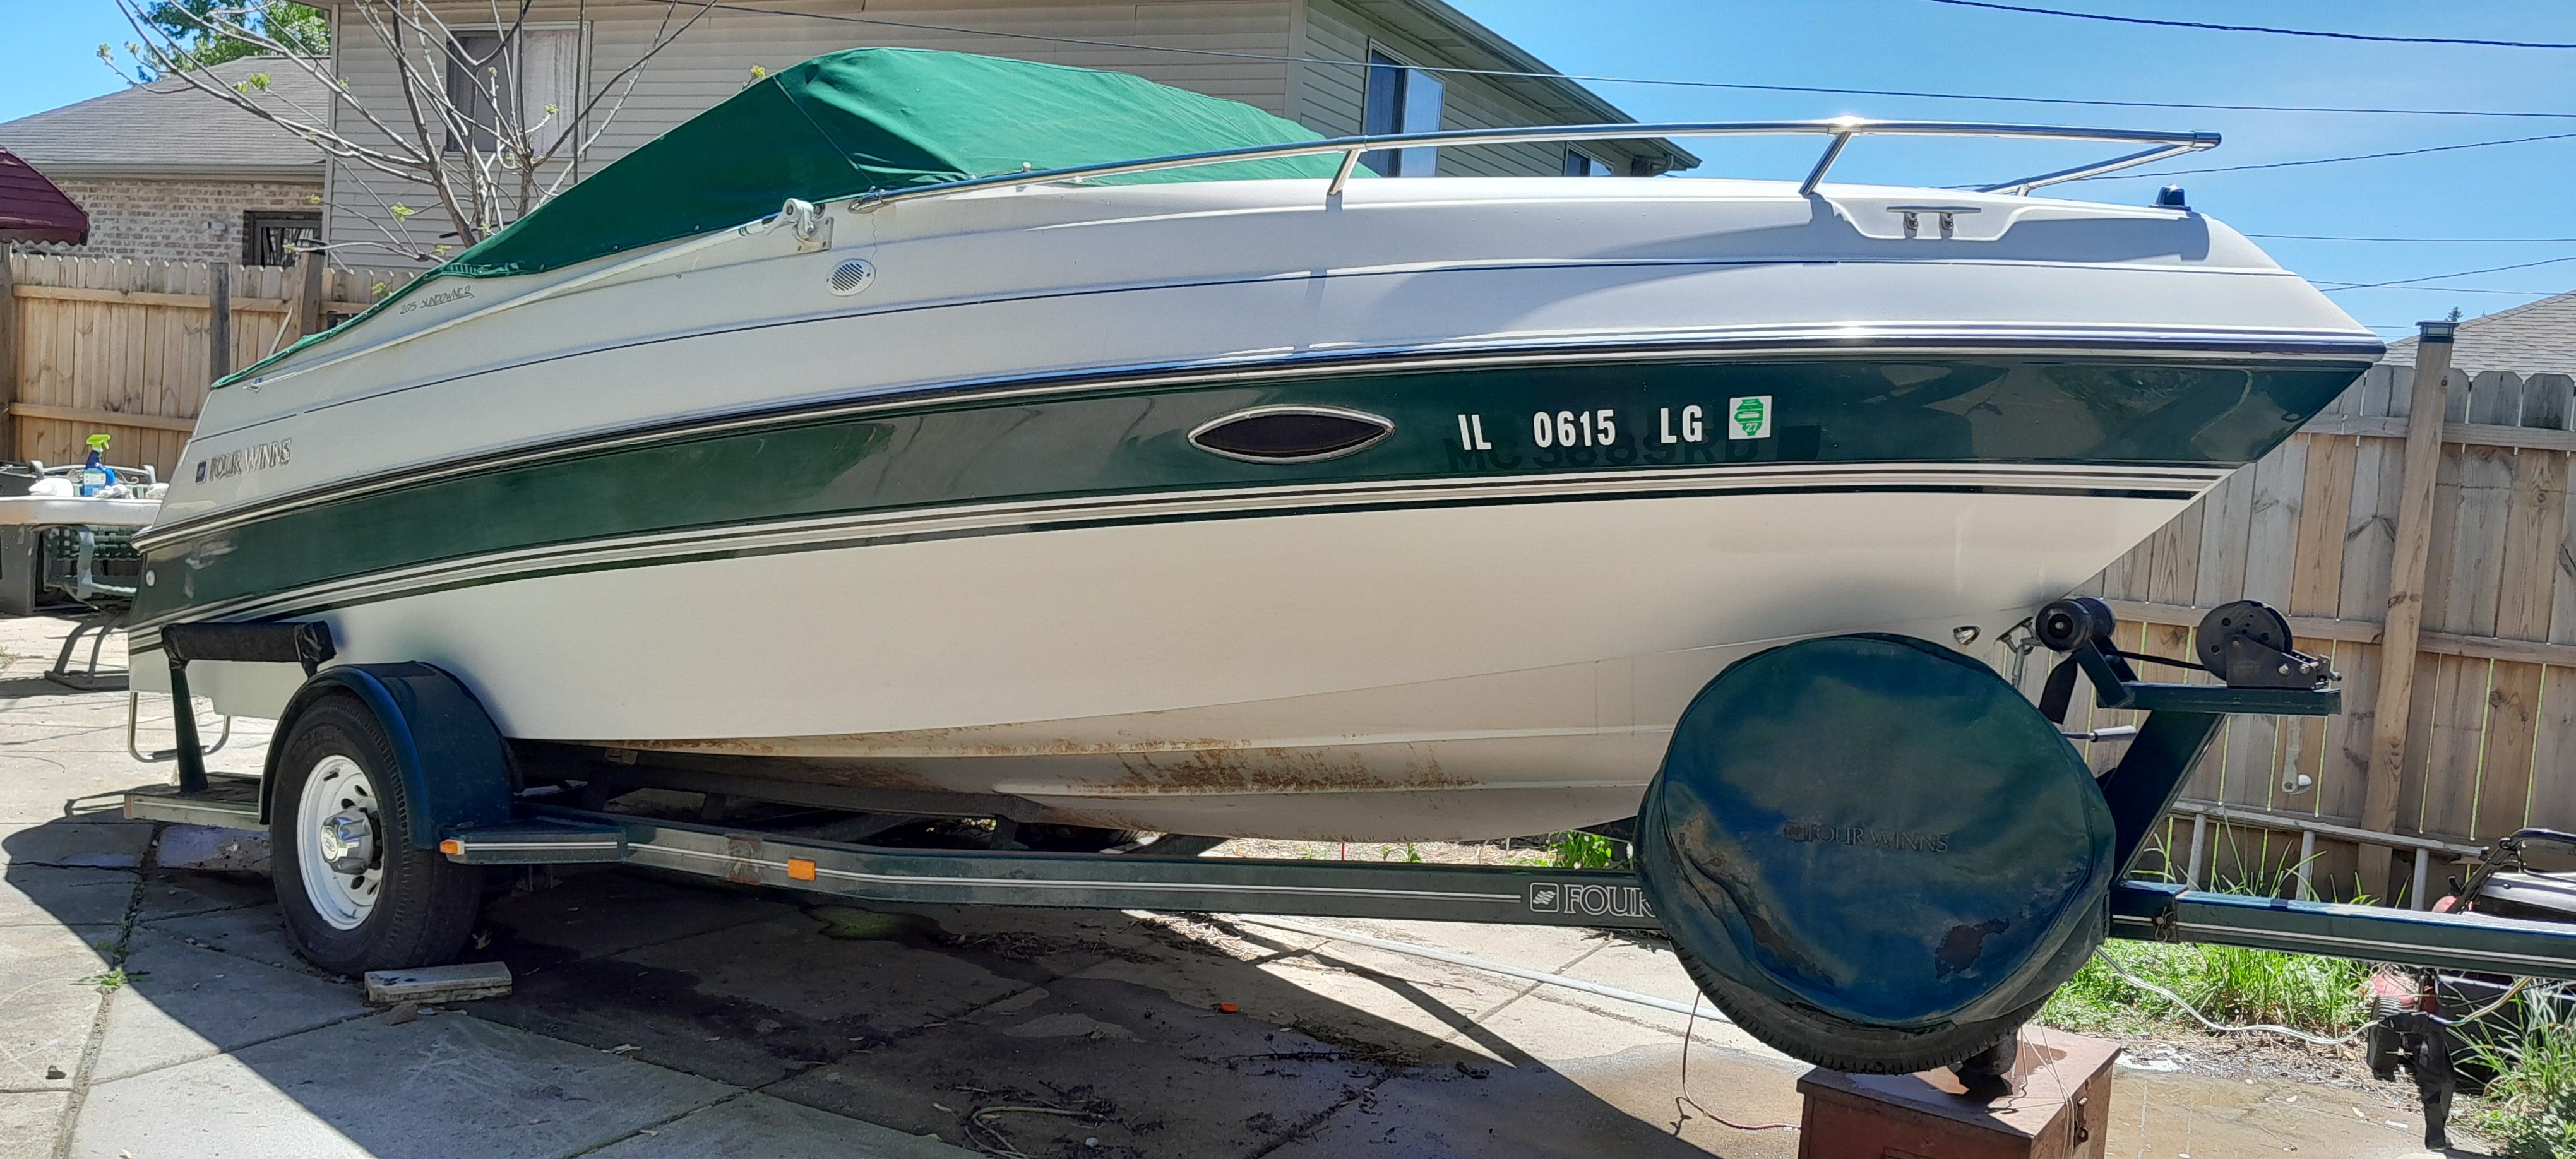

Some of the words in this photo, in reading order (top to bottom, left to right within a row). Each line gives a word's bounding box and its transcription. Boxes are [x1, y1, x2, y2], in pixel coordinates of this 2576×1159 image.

[400, 301, 417, 314] 205
[419, 285, 475, 309] SUNDOWNER
[1457, 413, 1492, 451] IL
[1532, 408, 1616, 448] 0615
[1660, 405, 1703, 444] LG
[1746, 423, 1758, 432] 27
[209, 449, 242, 482] FOUR
[244, 436, 292, 473] WINNS
[1807, 823, 1864, 846] FOUR
[1869, 829, 1950, 853] WINNS
[1563, 883, 1657, 918] FOUR
